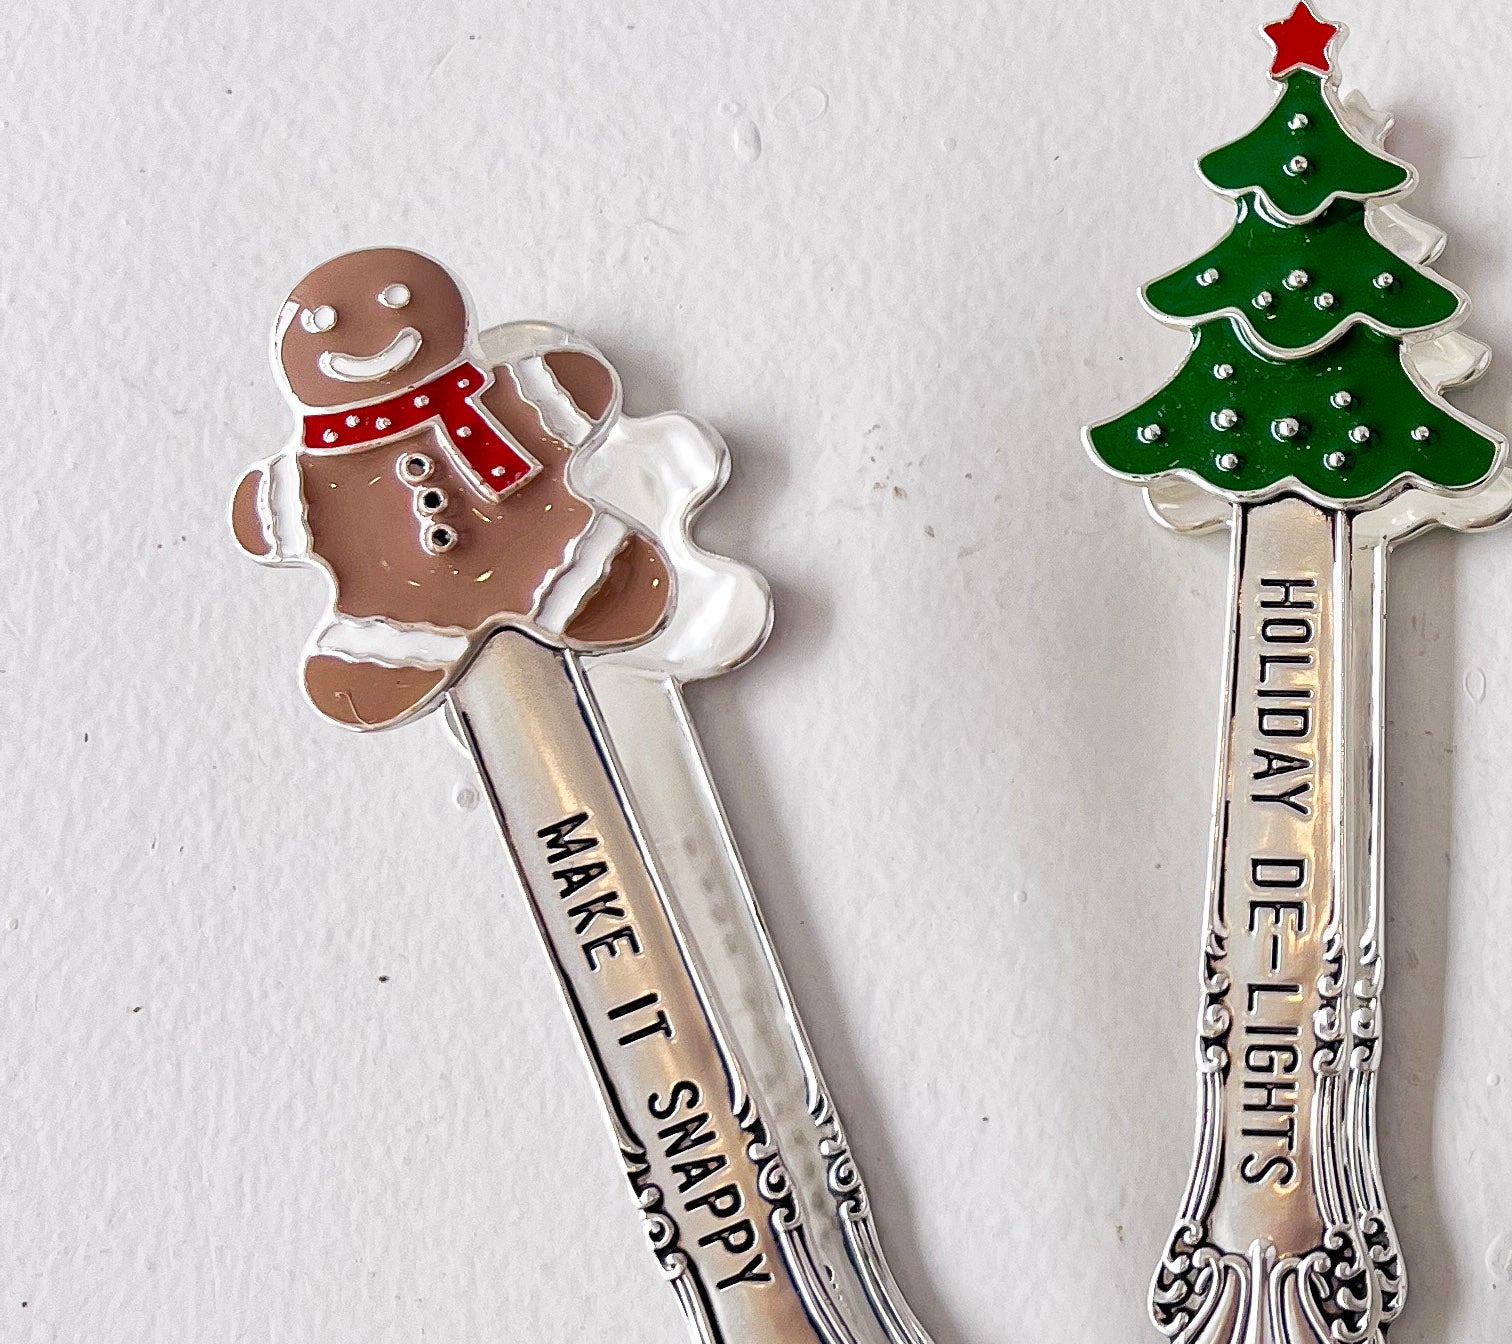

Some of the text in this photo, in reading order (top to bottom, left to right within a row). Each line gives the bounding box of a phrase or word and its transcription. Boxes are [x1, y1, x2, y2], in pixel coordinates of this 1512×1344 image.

[537, 811, 773, 1290] MAKE IT SNAPPY
[1239, 577, 1317, 1188] HOLIDAY DE-LIGHTS
